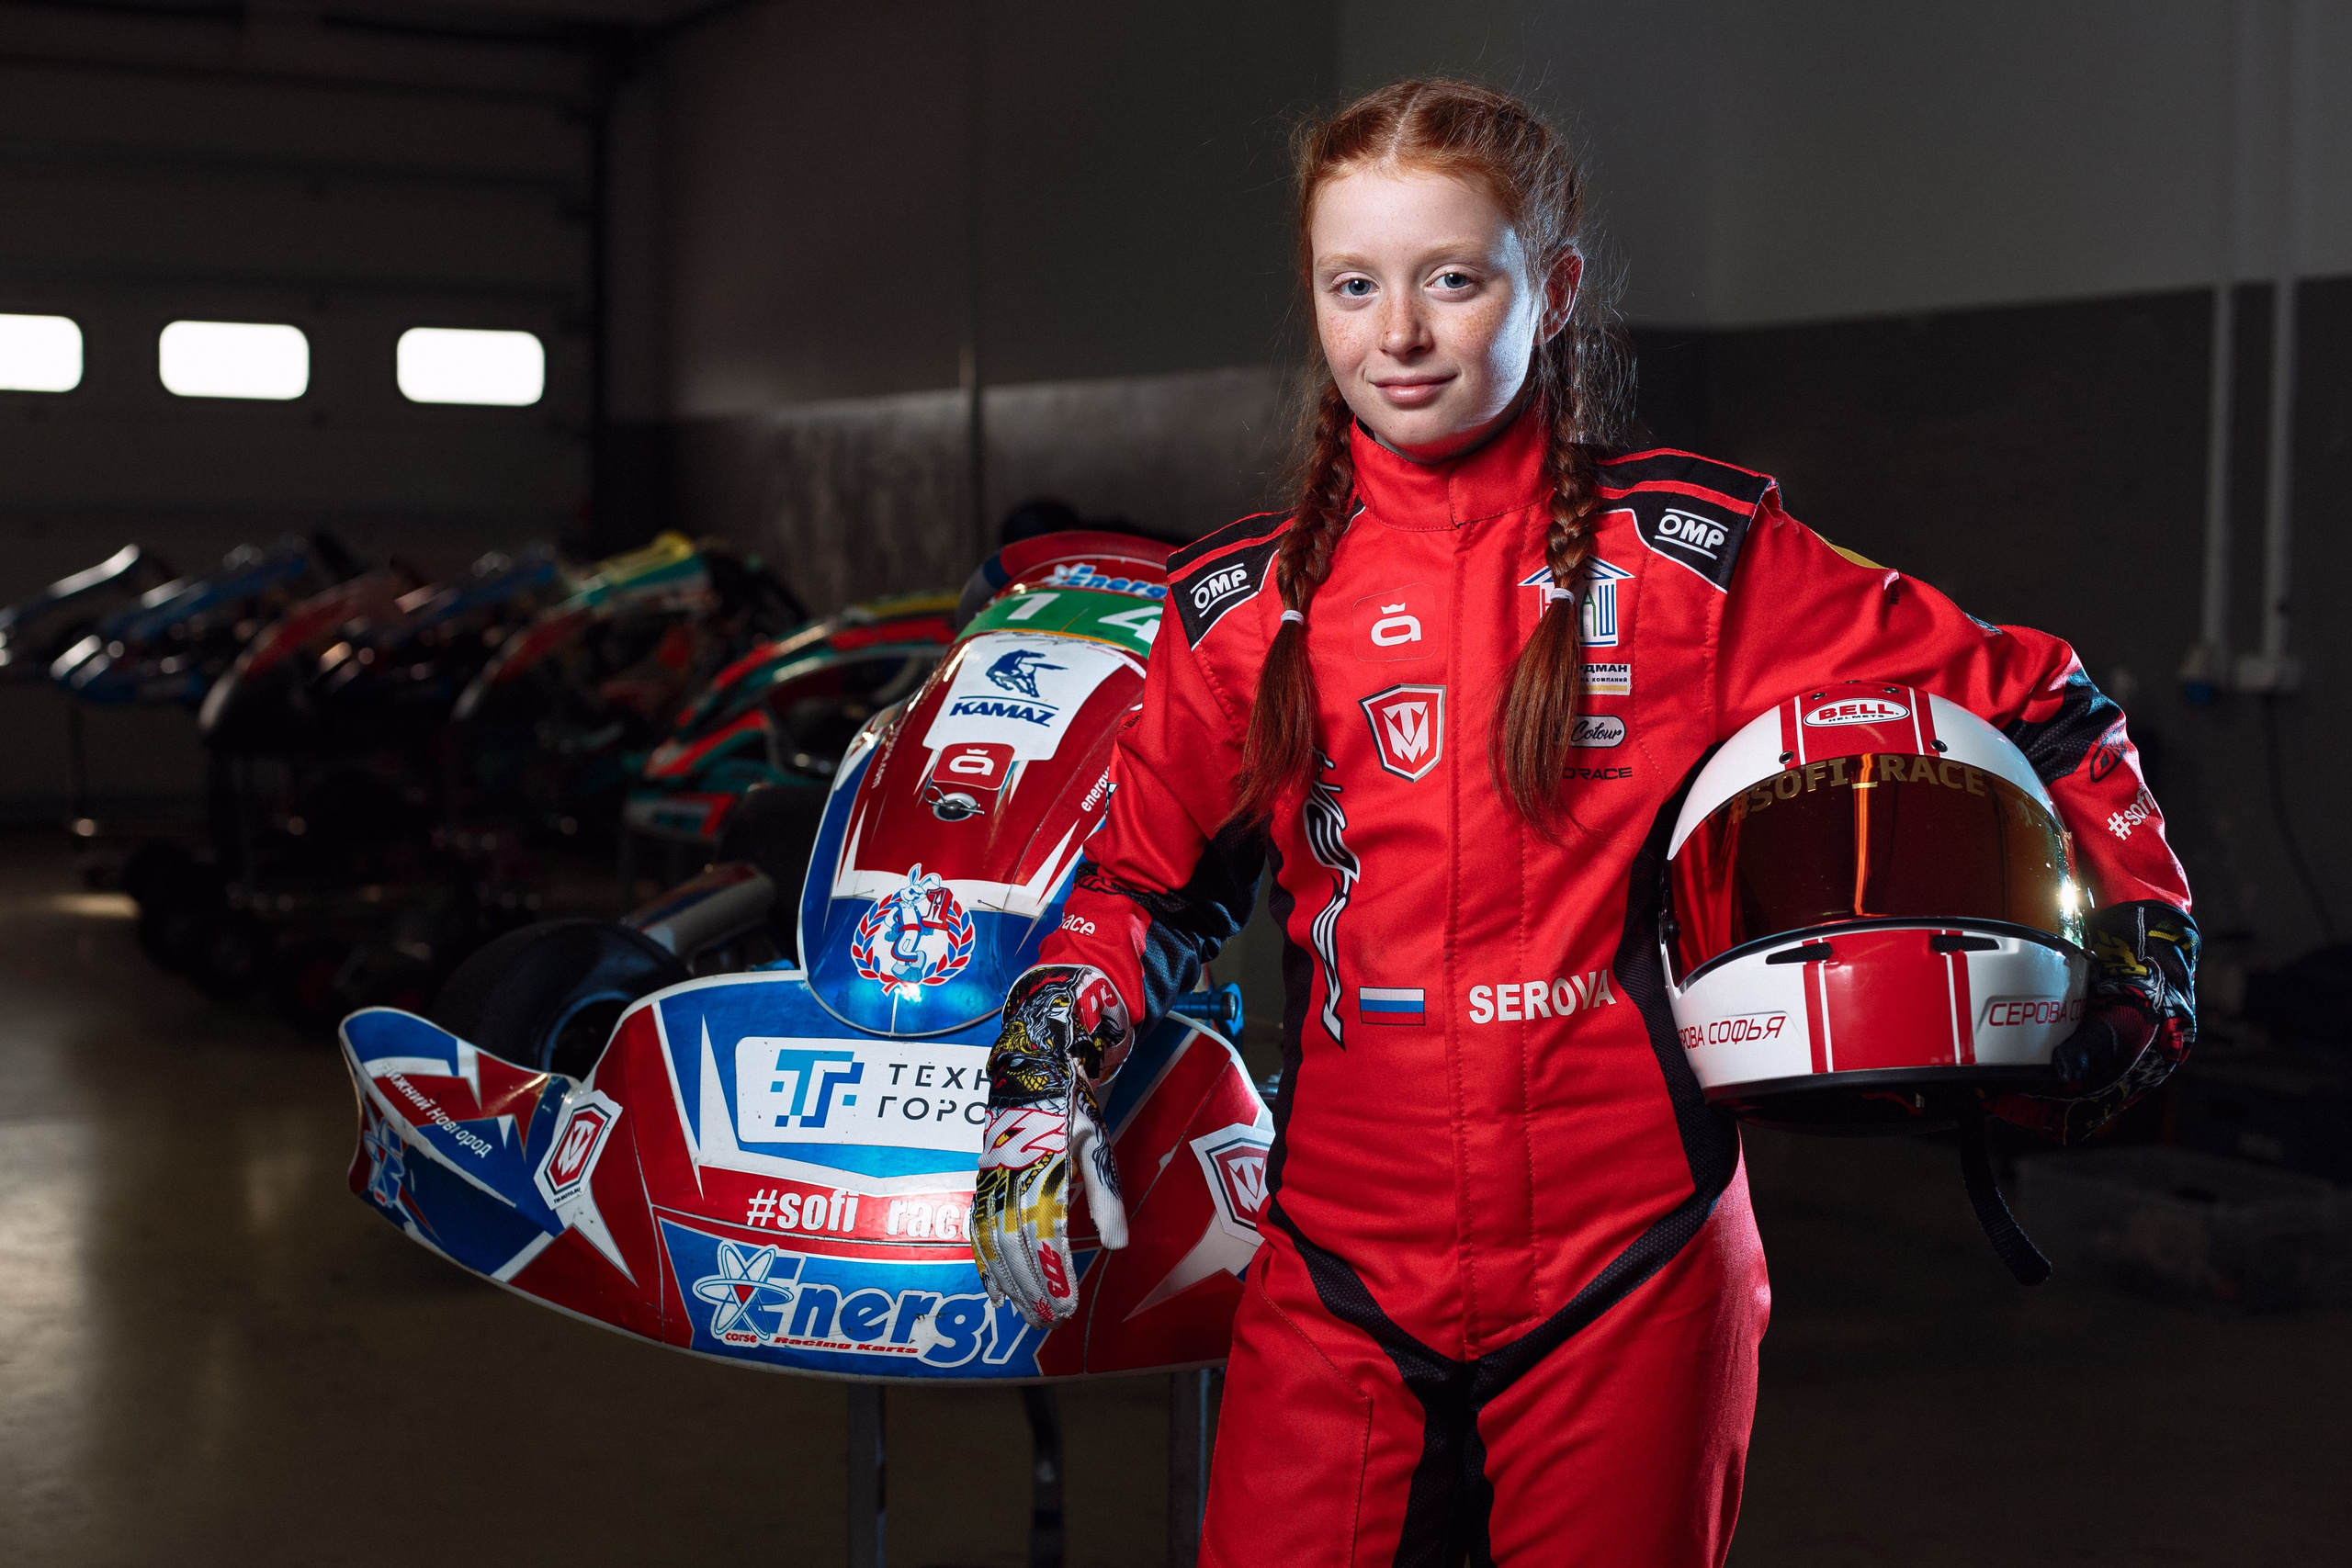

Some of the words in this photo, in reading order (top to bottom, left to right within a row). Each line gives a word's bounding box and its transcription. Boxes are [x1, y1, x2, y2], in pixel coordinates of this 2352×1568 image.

[1658, 513, 1725, 548] OMP
[1194, 570, 1248, 610] OMP
[1580, 664, 1627, 673] ДМАН
[949, 702, 1056, 728] KAMAZ
[1819, 704, 1894, 721] BELL
[1828, 714, 1885, 723] HELMETS
[1571, 720, 1623, 742] Colour
[2107, 785, 2155, 840] #sofi
[1061, 912, 1096, 936] ace
[1469, 969, 1617, 1024] SEROVA
[1988, 1001, 2067, 1026] СЕРОВА
[1709, 1016, 1786, 1045] СОФЬЯ
[747, 1189, 860, 1233] #sofi
[725, 1332, 757, 1344] corse
[774, 1337, 852, 1350] Racing
[855, 1344, 920, 1354] Karts
